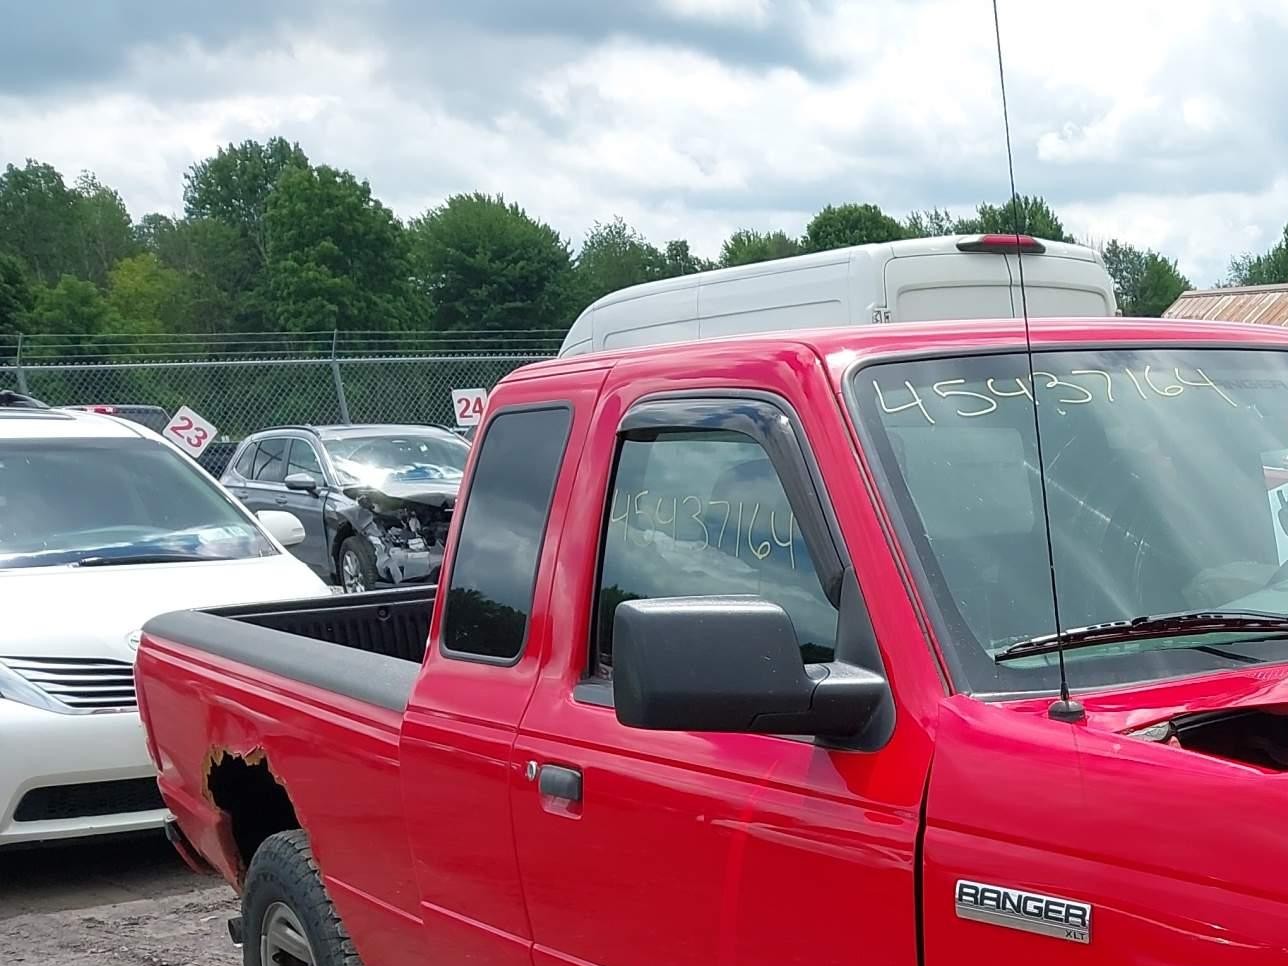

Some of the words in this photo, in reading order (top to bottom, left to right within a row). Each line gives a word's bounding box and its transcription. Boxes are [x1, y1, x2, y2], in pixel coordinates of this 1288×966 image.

[457, 397, 484, 418] 24
[872, 366, 1238, 425] 45437164
[170, 415, 208, 448] 23
[611, 489, 796, 569] 45437164
[957, 882, 1088, 928] RANGER
[1065, 928, 1087, 941] XLT
